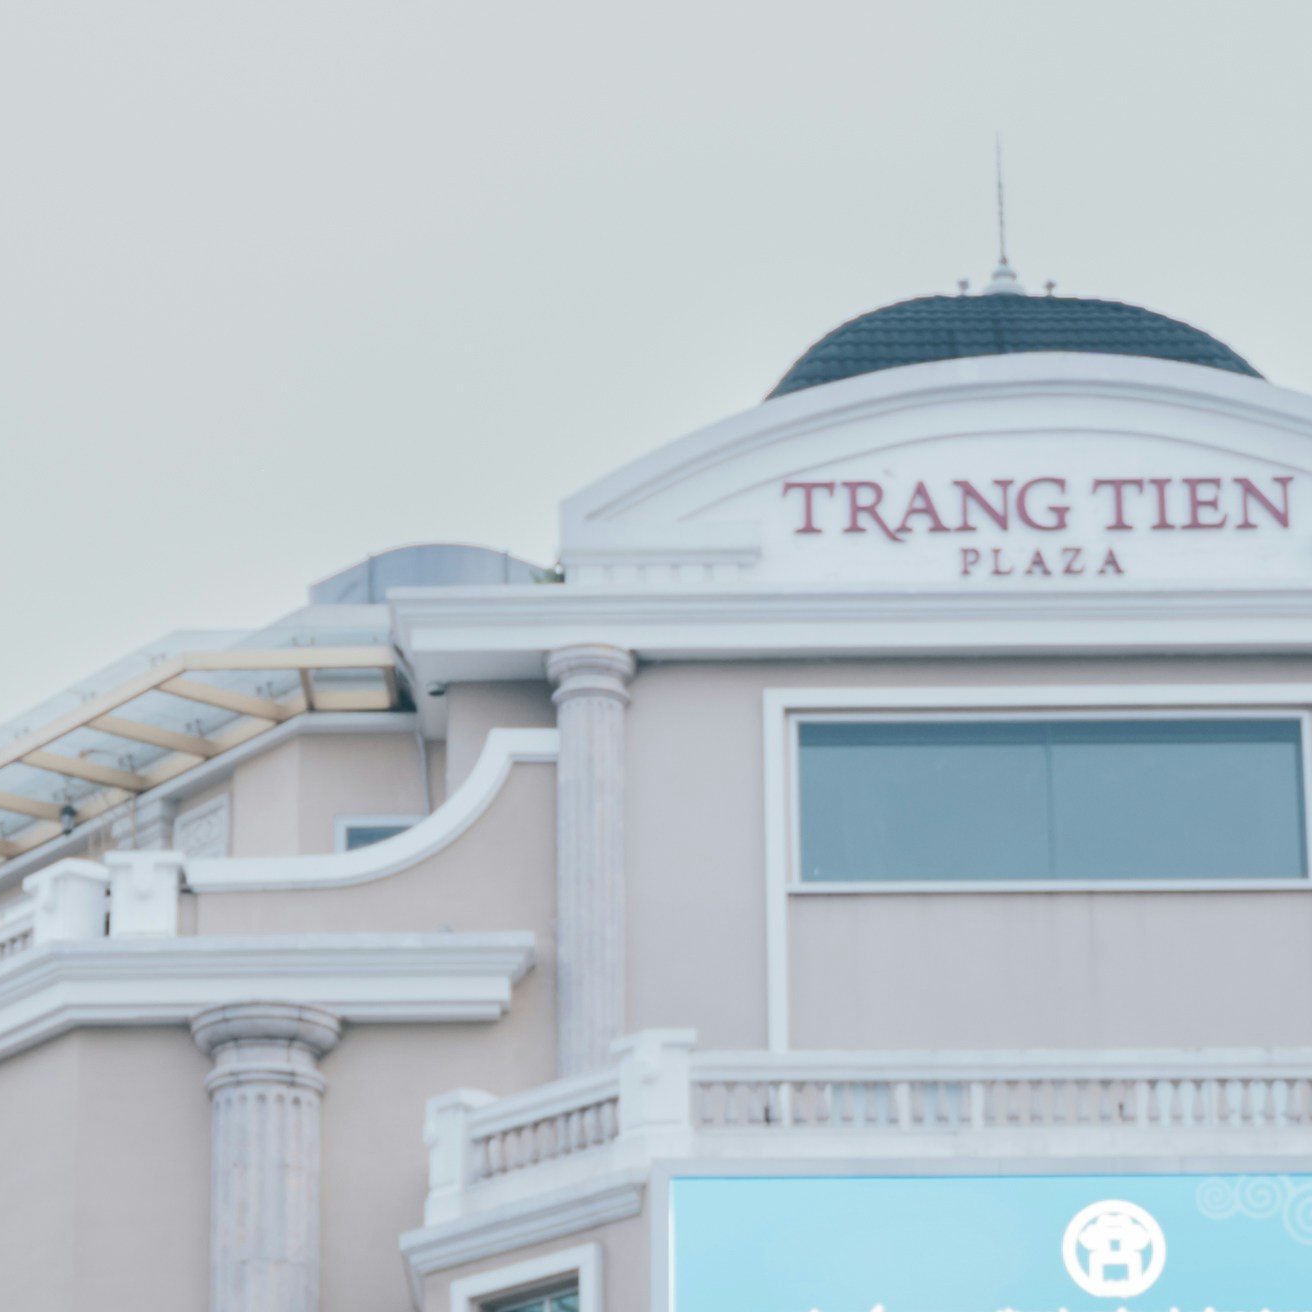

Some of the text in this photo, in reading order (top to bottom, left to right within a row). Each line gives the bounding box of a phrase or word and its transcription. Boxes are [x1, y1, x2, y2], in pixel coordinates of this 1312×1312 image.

[782, 476, 1294, 541] TRANG TIEN
[960, 548, 1125, 577] PLAZA
